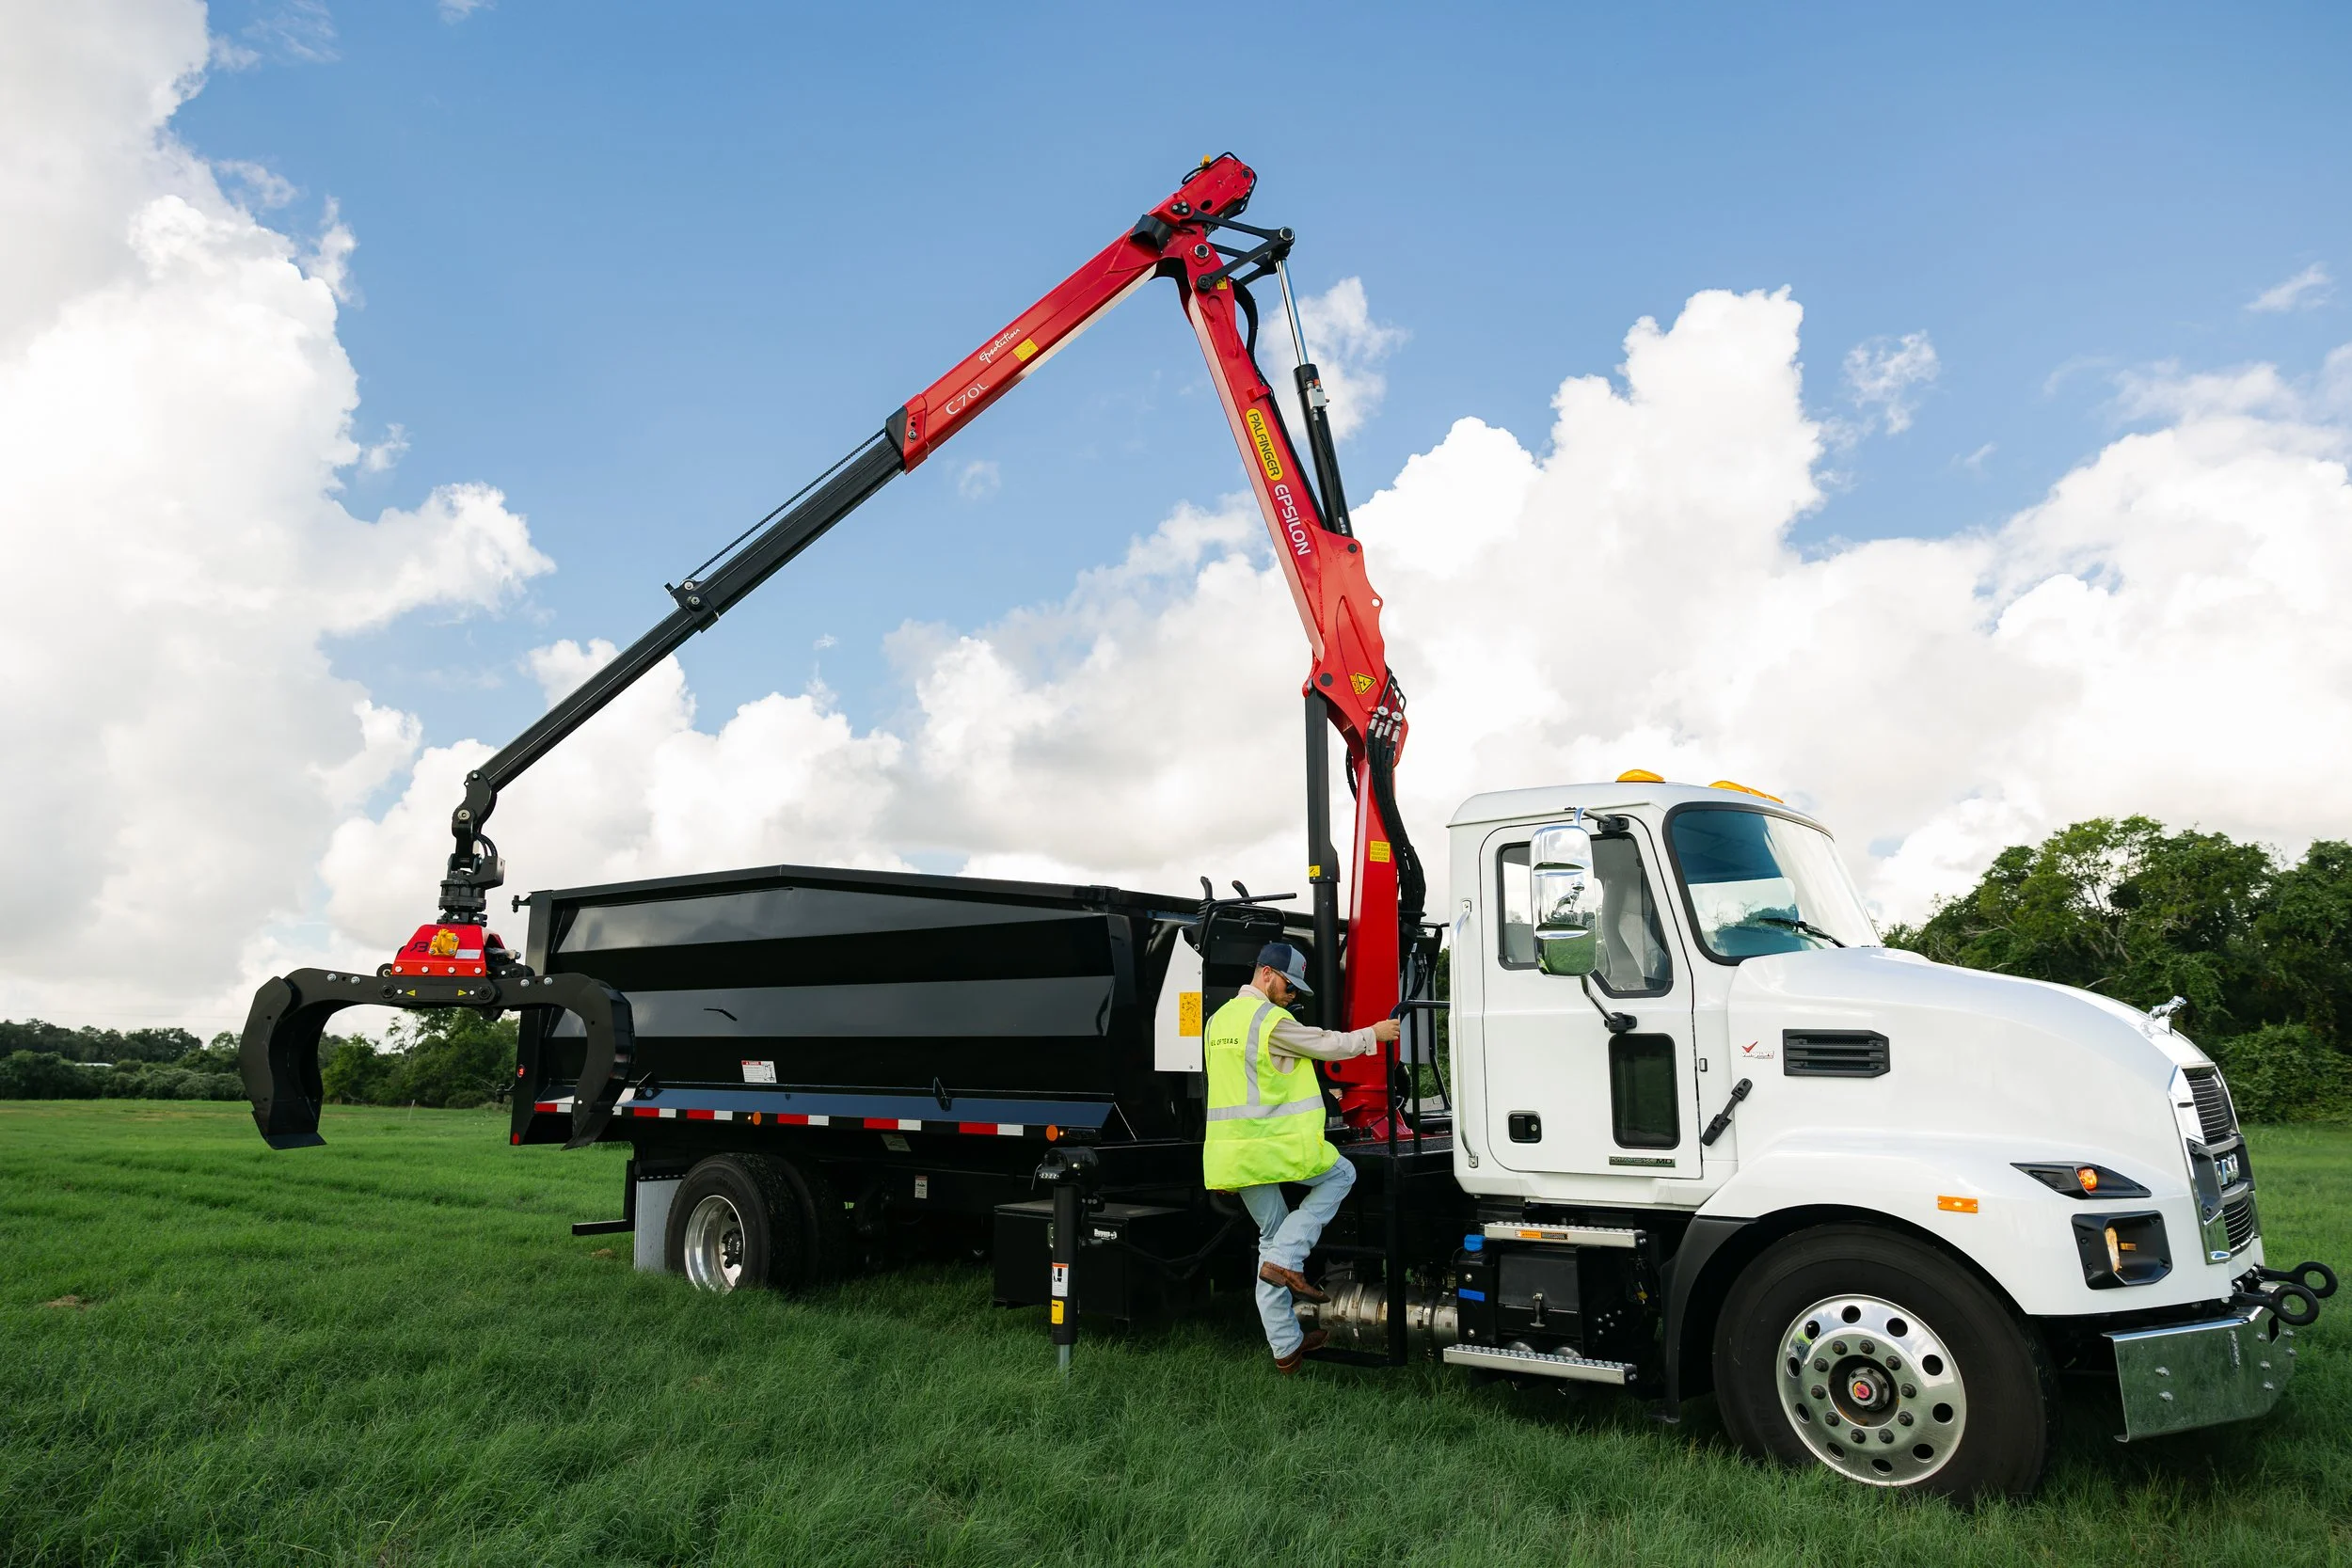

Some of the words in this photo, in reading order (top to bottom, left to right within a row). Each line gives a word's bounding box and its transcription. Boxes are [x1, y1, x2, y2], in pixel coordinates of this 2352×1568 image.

[946, 382, 990, 416] C70L
[1248, 413, 1280, 477] PALFINGER
[1275, 484, 1311, 557] EPSILON
